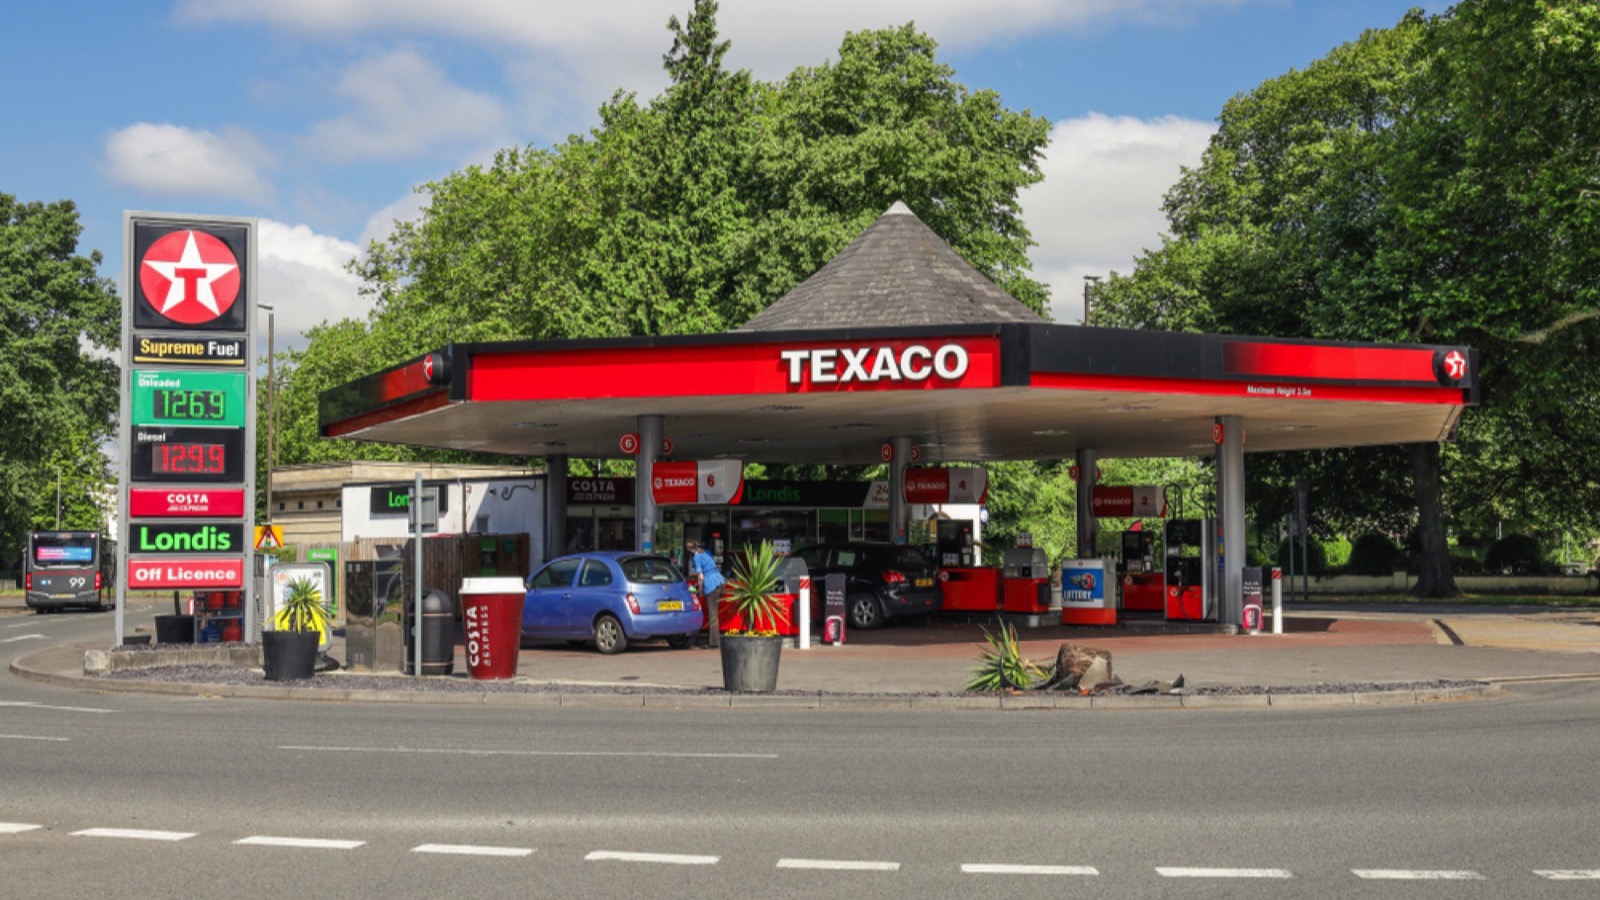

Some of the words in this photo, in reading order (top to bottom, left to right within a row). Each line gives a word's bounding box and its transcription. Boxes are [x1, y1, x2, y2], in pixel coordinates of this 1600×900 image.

[140, 338, 204, 357] Supreme
[207, 341, 239, 356] Fuel
[781, 344, 969, 383] TEXACO
[138, 379, 181, 388] Unleaded
[161, 390, 224, 418] 126.9
[138, 432, 166, 442] Diesel
[160, 444, 224, 472] 129.9
[572, 481, 615, 492] COSTA
[664, 478, 694, 488] TEXACO
[707, 474, 715, 487] 6
[958, 480, 966, 490] 4
[167, 494, 208, 505] COSTA
[388, 491, 410, 508] Lon
[747, 485, 800, 501] Londis
[140, 526, 231, 550] Londis
[135, 567, 162, 581] Off
[167, 568, 236, 581] Licence
[69, 577, 86, 588] 99
[1063, 589, 1092, 600] LOTTERY
[466, 605, 480, 667] COSTA
[481, 605, 491, 663] EXPRESS
